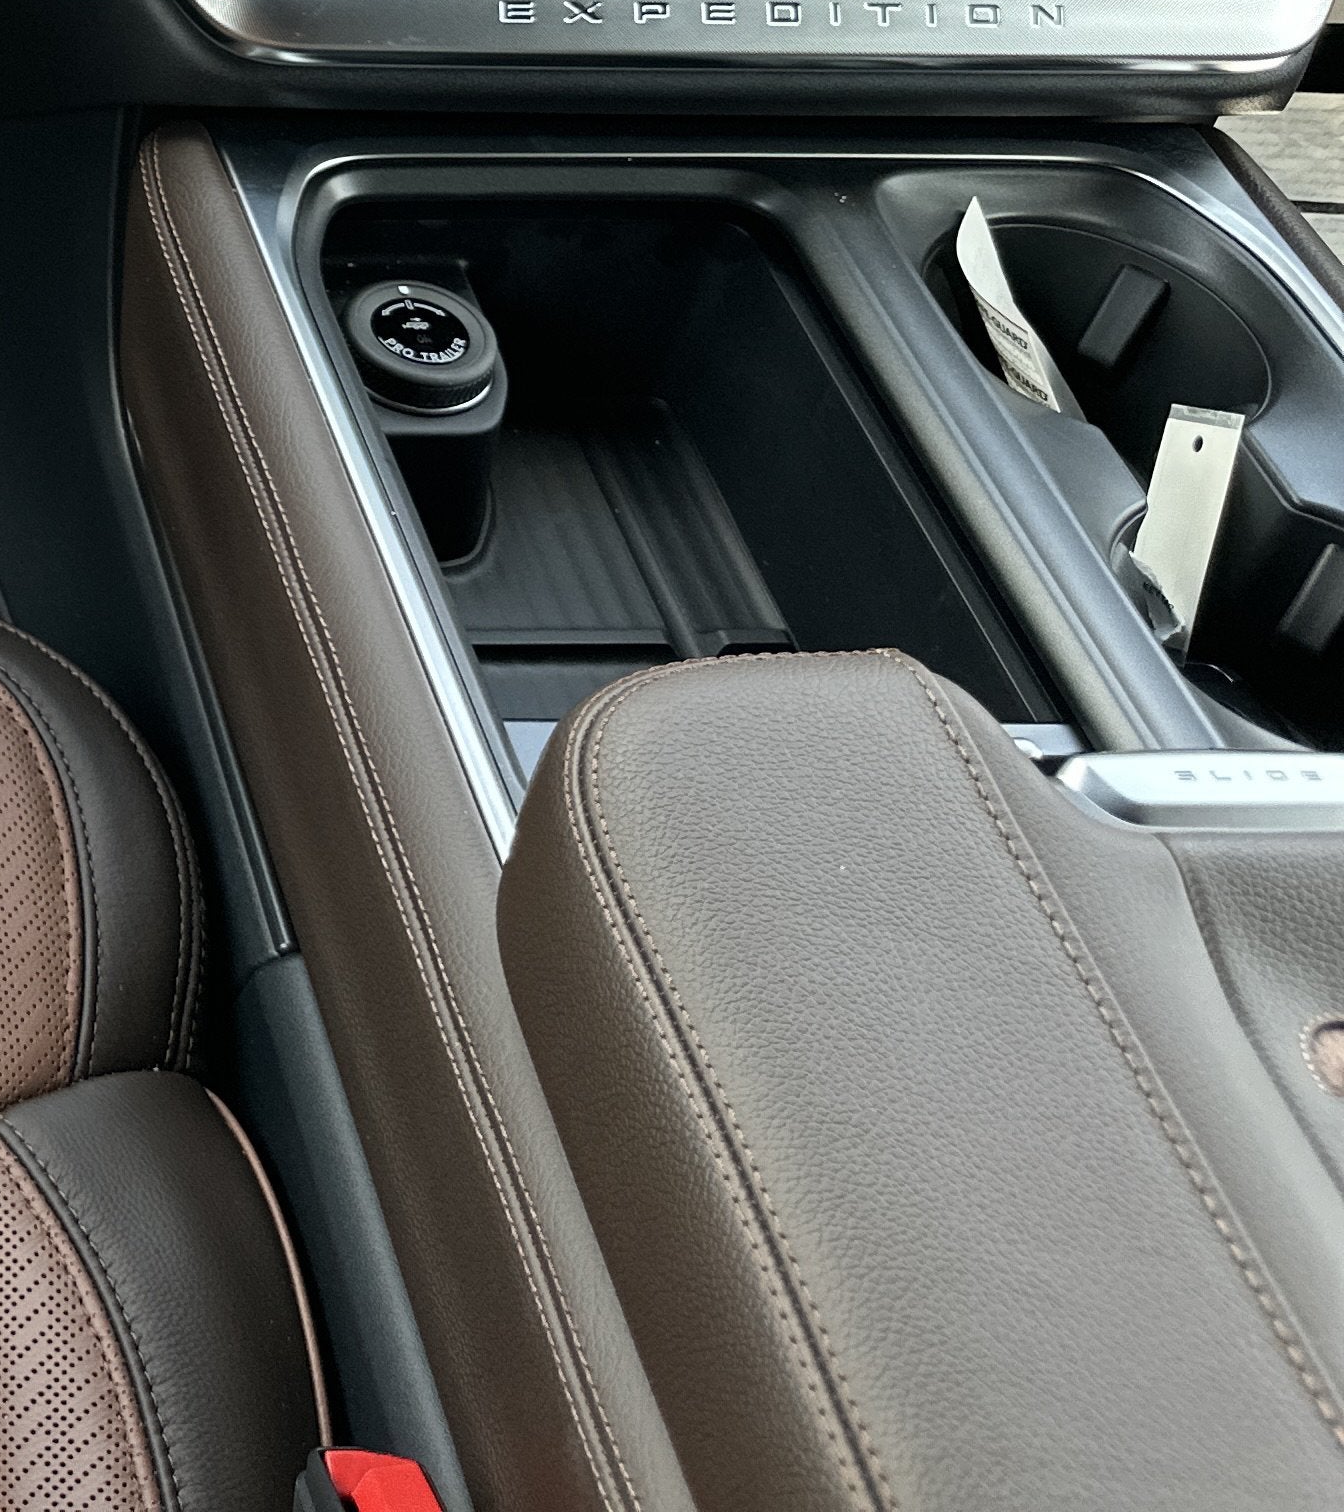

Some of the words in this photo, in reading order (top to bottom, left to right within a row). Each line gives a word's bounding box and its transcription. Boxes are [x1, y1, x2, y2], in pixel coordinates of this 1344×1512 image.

[498, 0, 1066, 27] EXPEDITION
[384, 337, 415, 360] PRO
[420, 337, 467, 364] TRAILER
[1173, 769, 1323, 781] SLIDE
